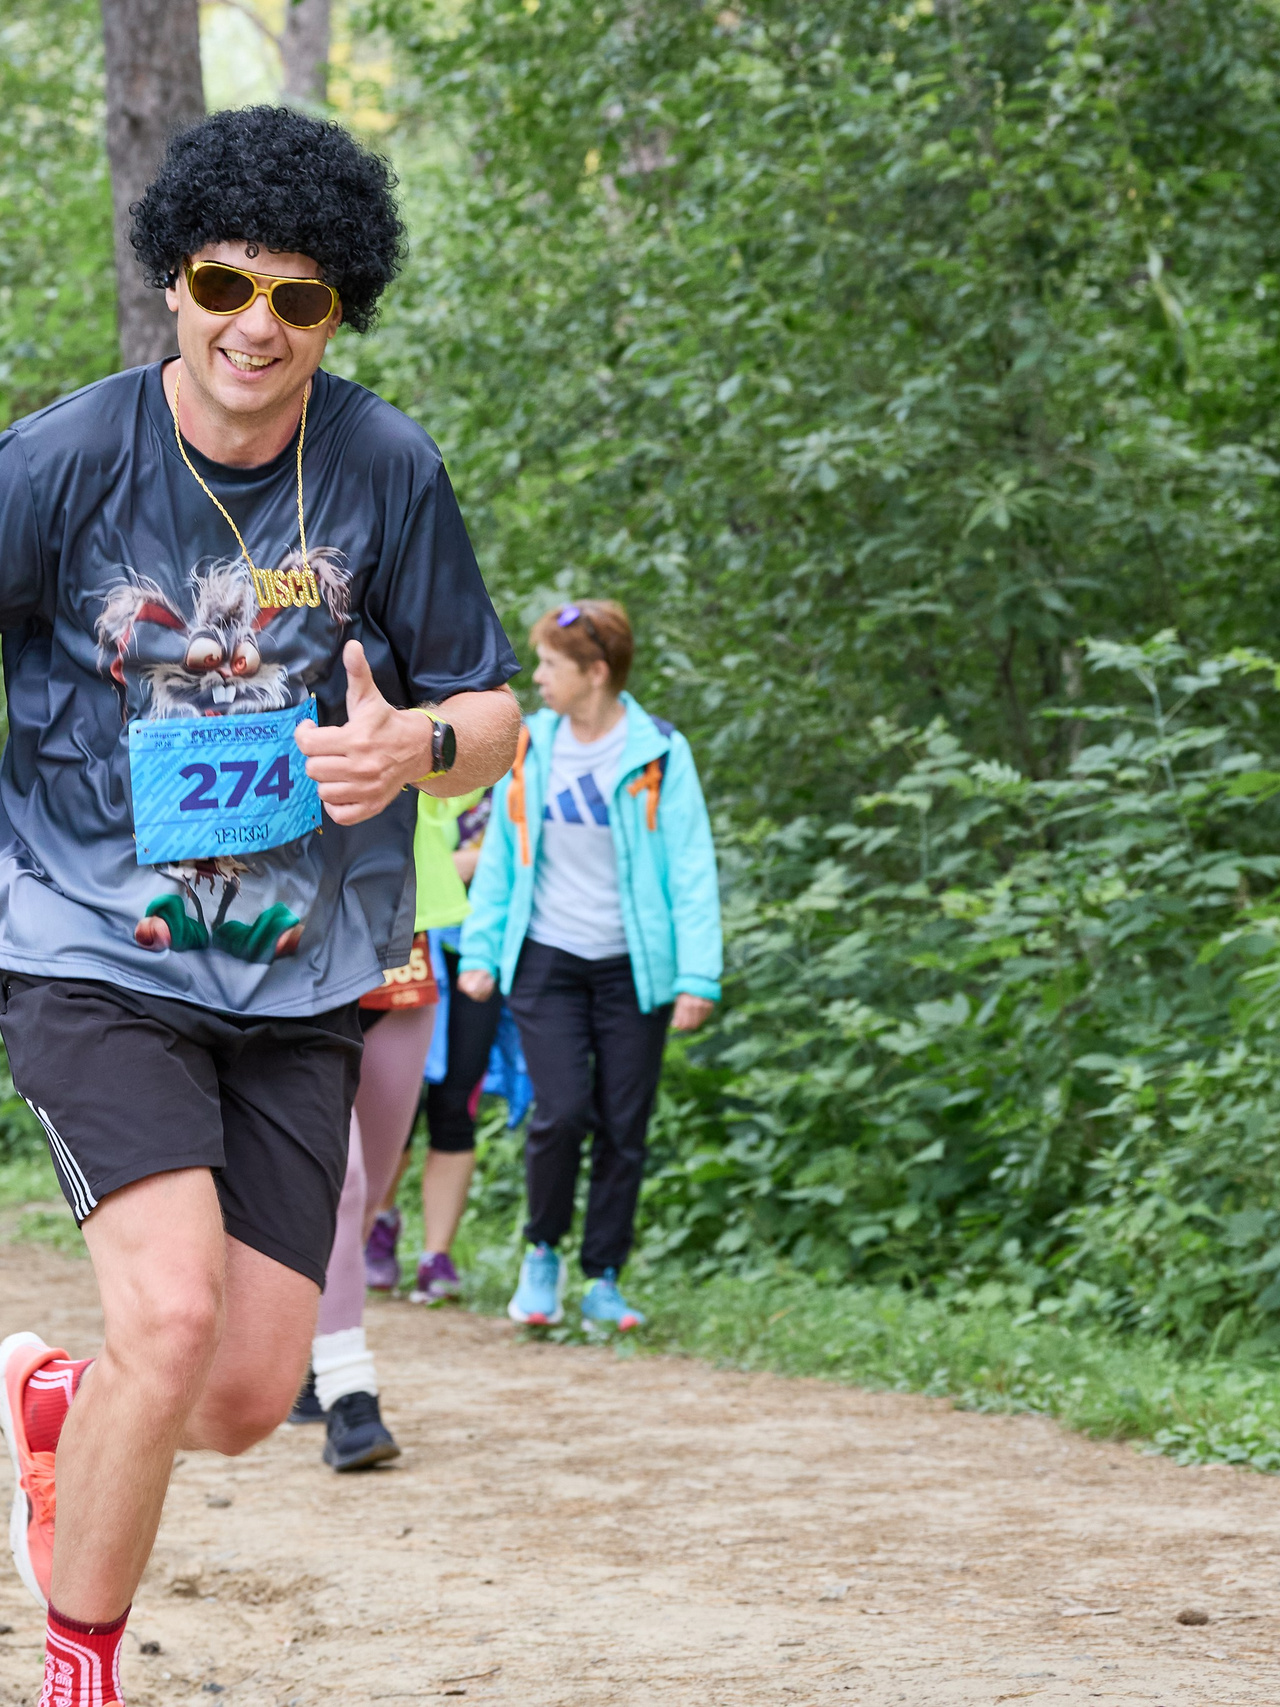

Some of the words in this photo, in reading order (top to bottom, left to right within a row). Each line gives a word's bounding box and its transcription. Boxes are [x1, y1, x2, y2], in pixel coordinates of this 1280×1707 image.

[253, 568, 321, 609] DISCO
[191, 728, 232, 740] РЕТРО
[235, 724, 278, 738] КРОСС
[178, 754, 294, 812] 274
[215, 827, 237, 844] 12
